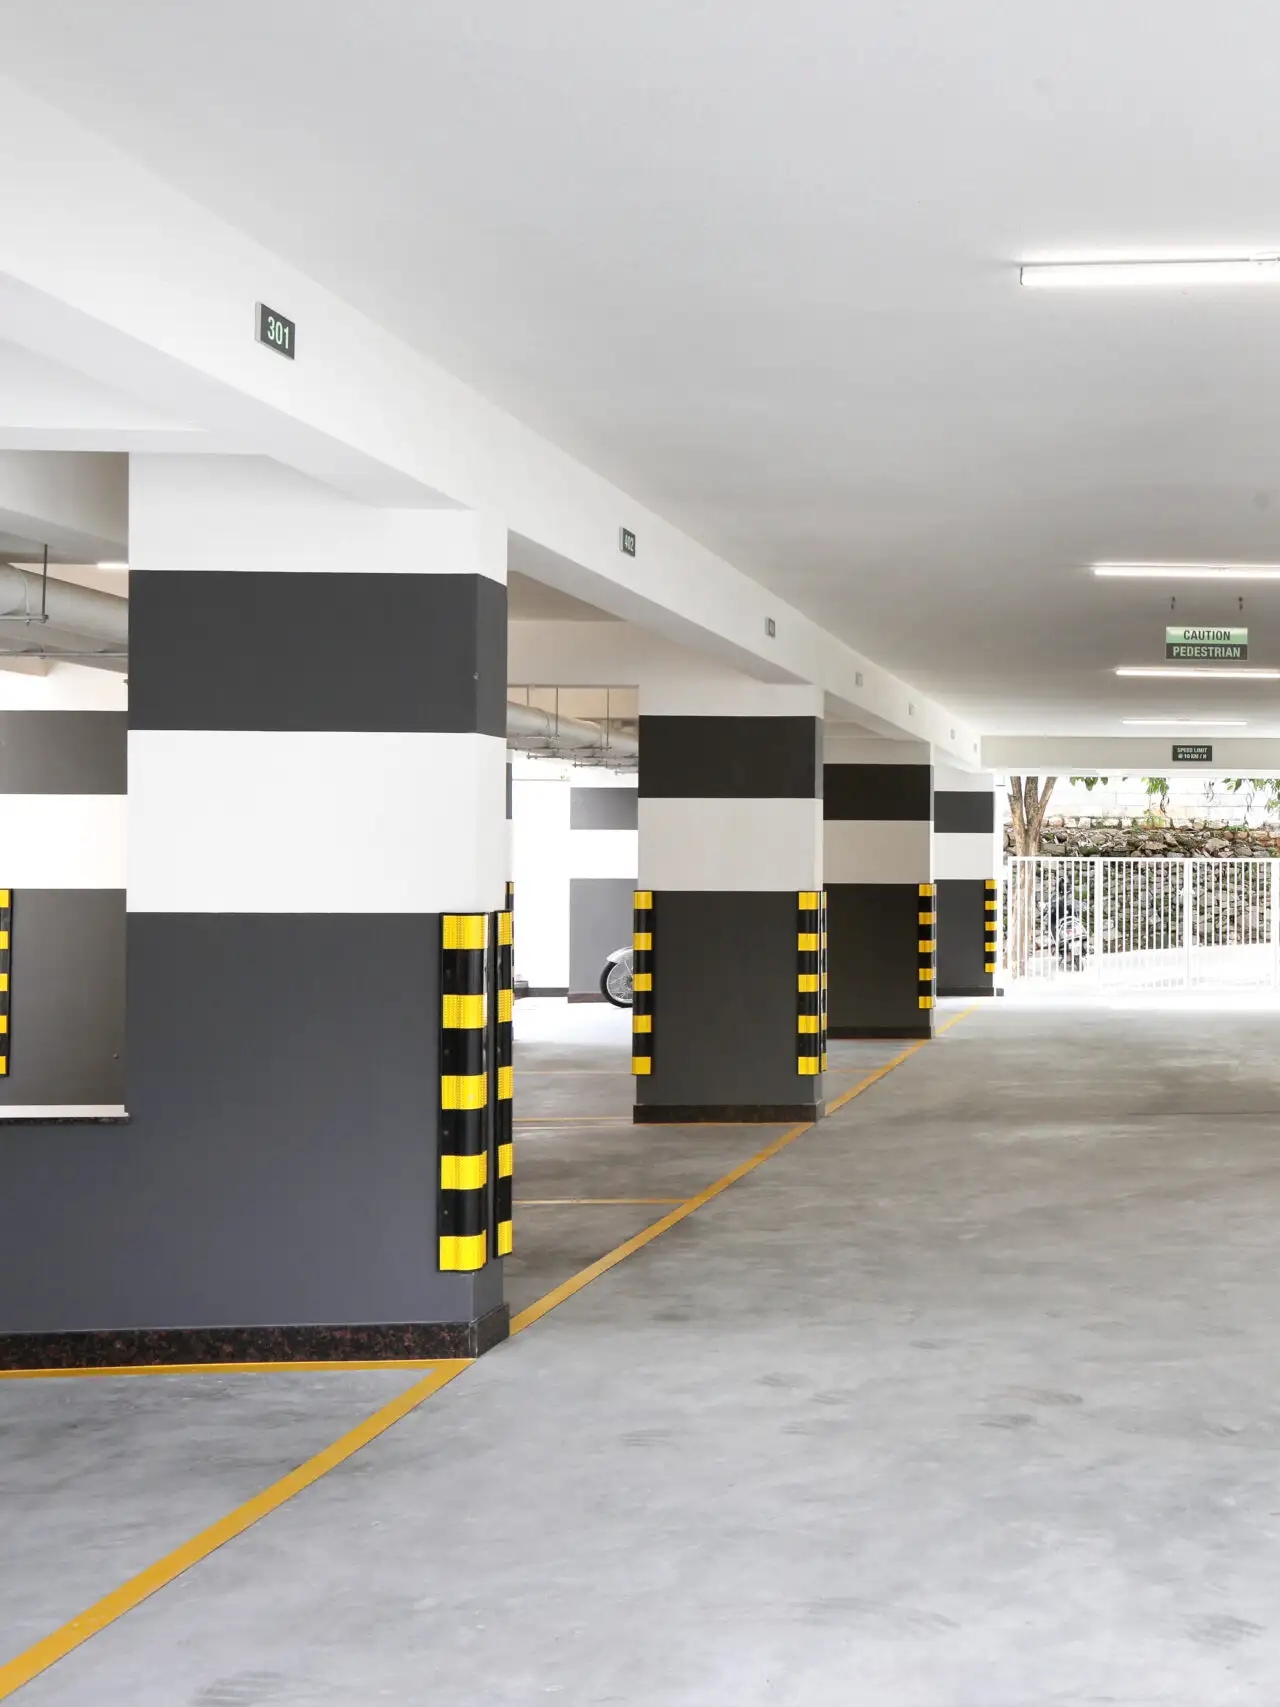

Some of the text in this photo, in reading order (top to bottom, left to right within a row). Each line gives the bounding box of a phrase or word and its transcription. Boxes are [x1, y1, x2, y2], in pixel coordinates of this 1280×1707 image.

[267, 315, 289, 349] 301
[1183, 630, 1231, 641] CAUTION
[1172, 646, 1241, 658] PEDESTRIAN
